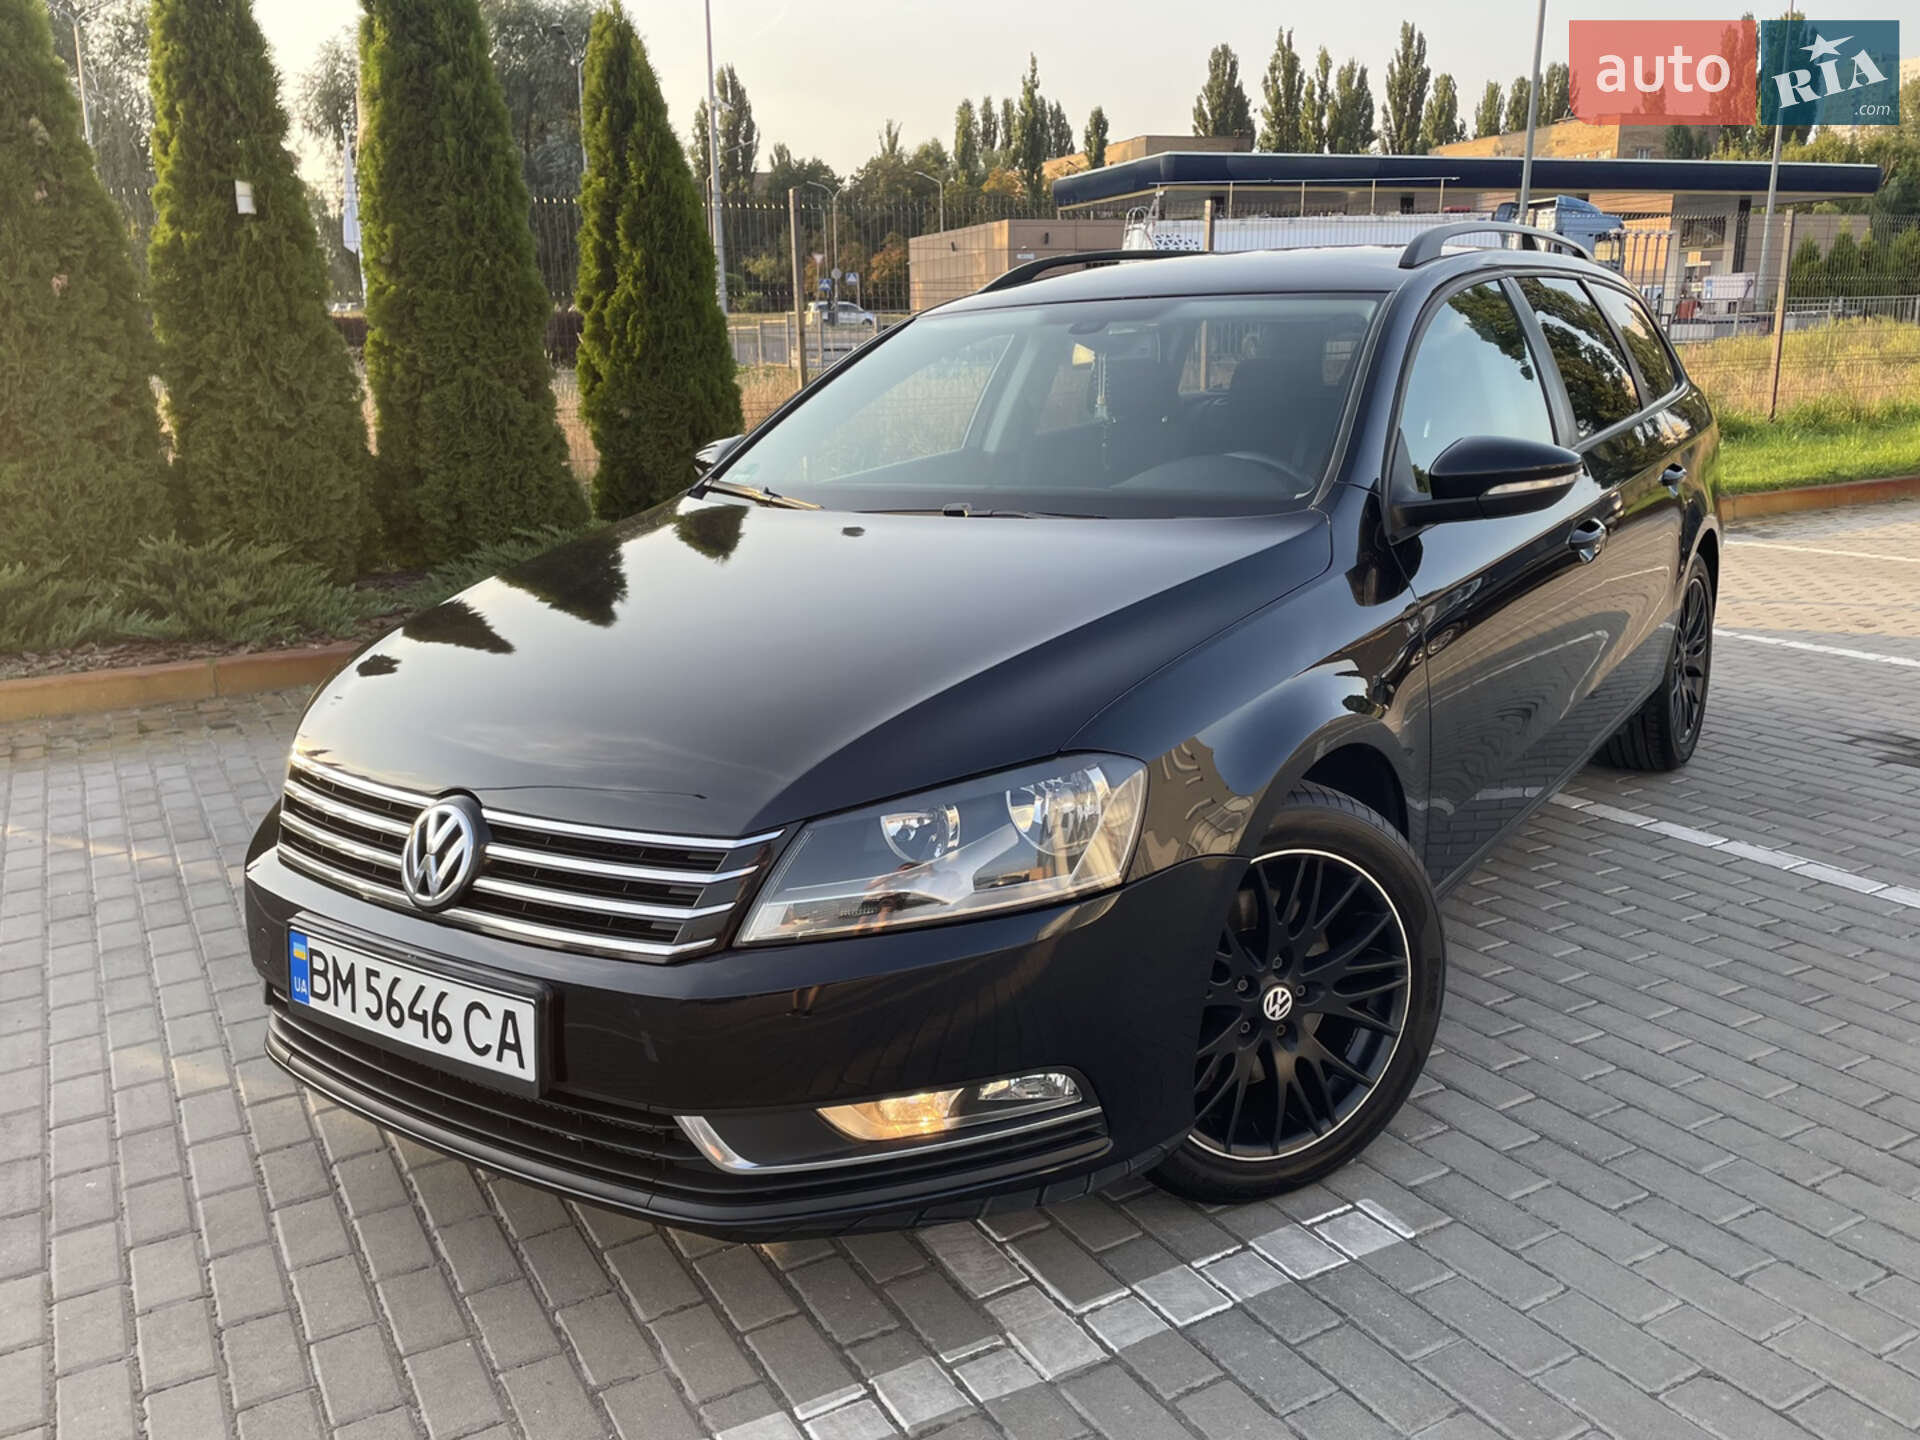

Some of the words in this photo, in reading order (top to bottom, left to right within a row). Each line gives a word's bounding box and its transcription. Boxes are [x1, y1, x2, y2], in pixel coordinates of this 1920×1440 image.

[293, 976, 308, 995] UA
[309, 947, 357, 1014] BM
[365, 967, 453, 1045] 5646
[463, 1001, 526, 1070] CA
